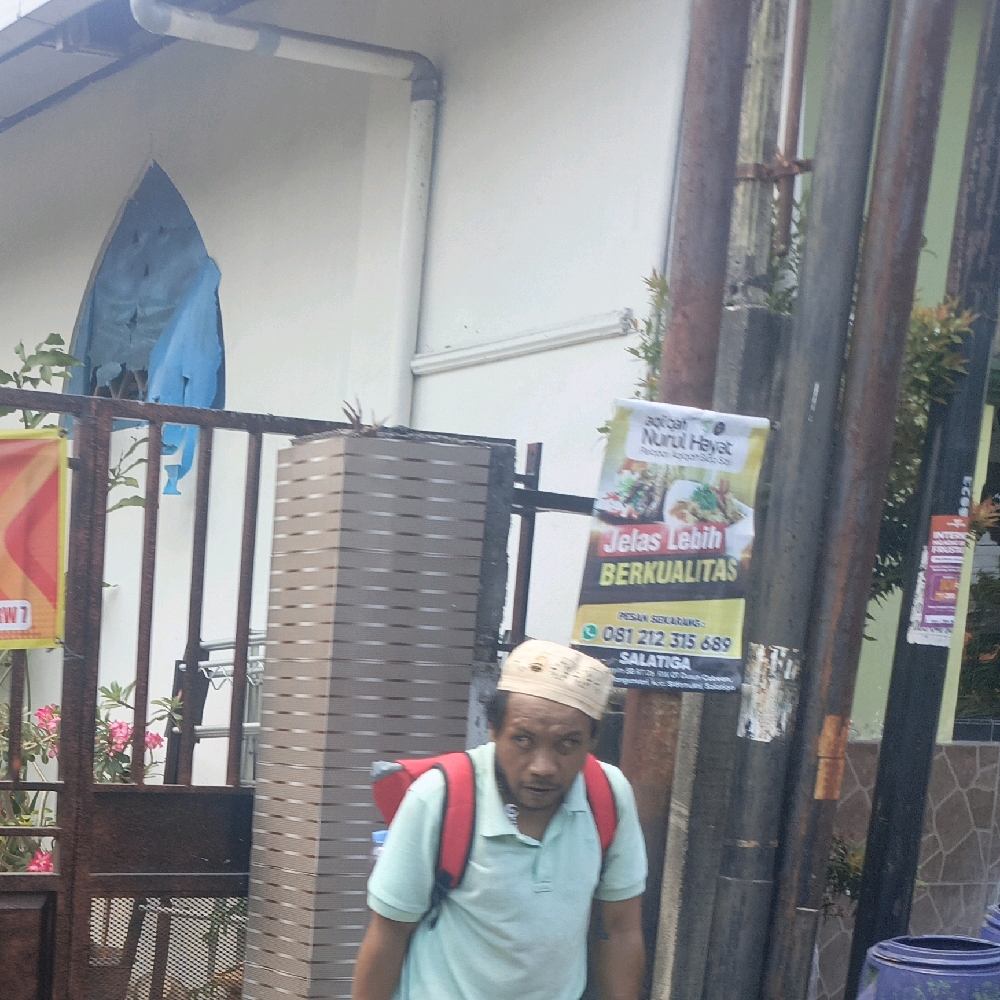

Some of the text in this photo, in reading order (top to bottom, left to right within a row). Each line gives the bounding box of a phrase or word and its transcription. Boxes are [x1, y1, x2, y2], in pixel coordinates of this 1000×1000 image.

[641, 428, 733, 456] Nurul Hayat
[603, 525, 723, 554] Jelas Lebih
[600, 558, 738, 586] BERKUALITAS
[19, 606, 28, 624] 7
[617, 611, 648, 623] PESAN
[603, 626, 732, 653] 081 212 315 689
[619, 651, 692, 671] SALATIGA
